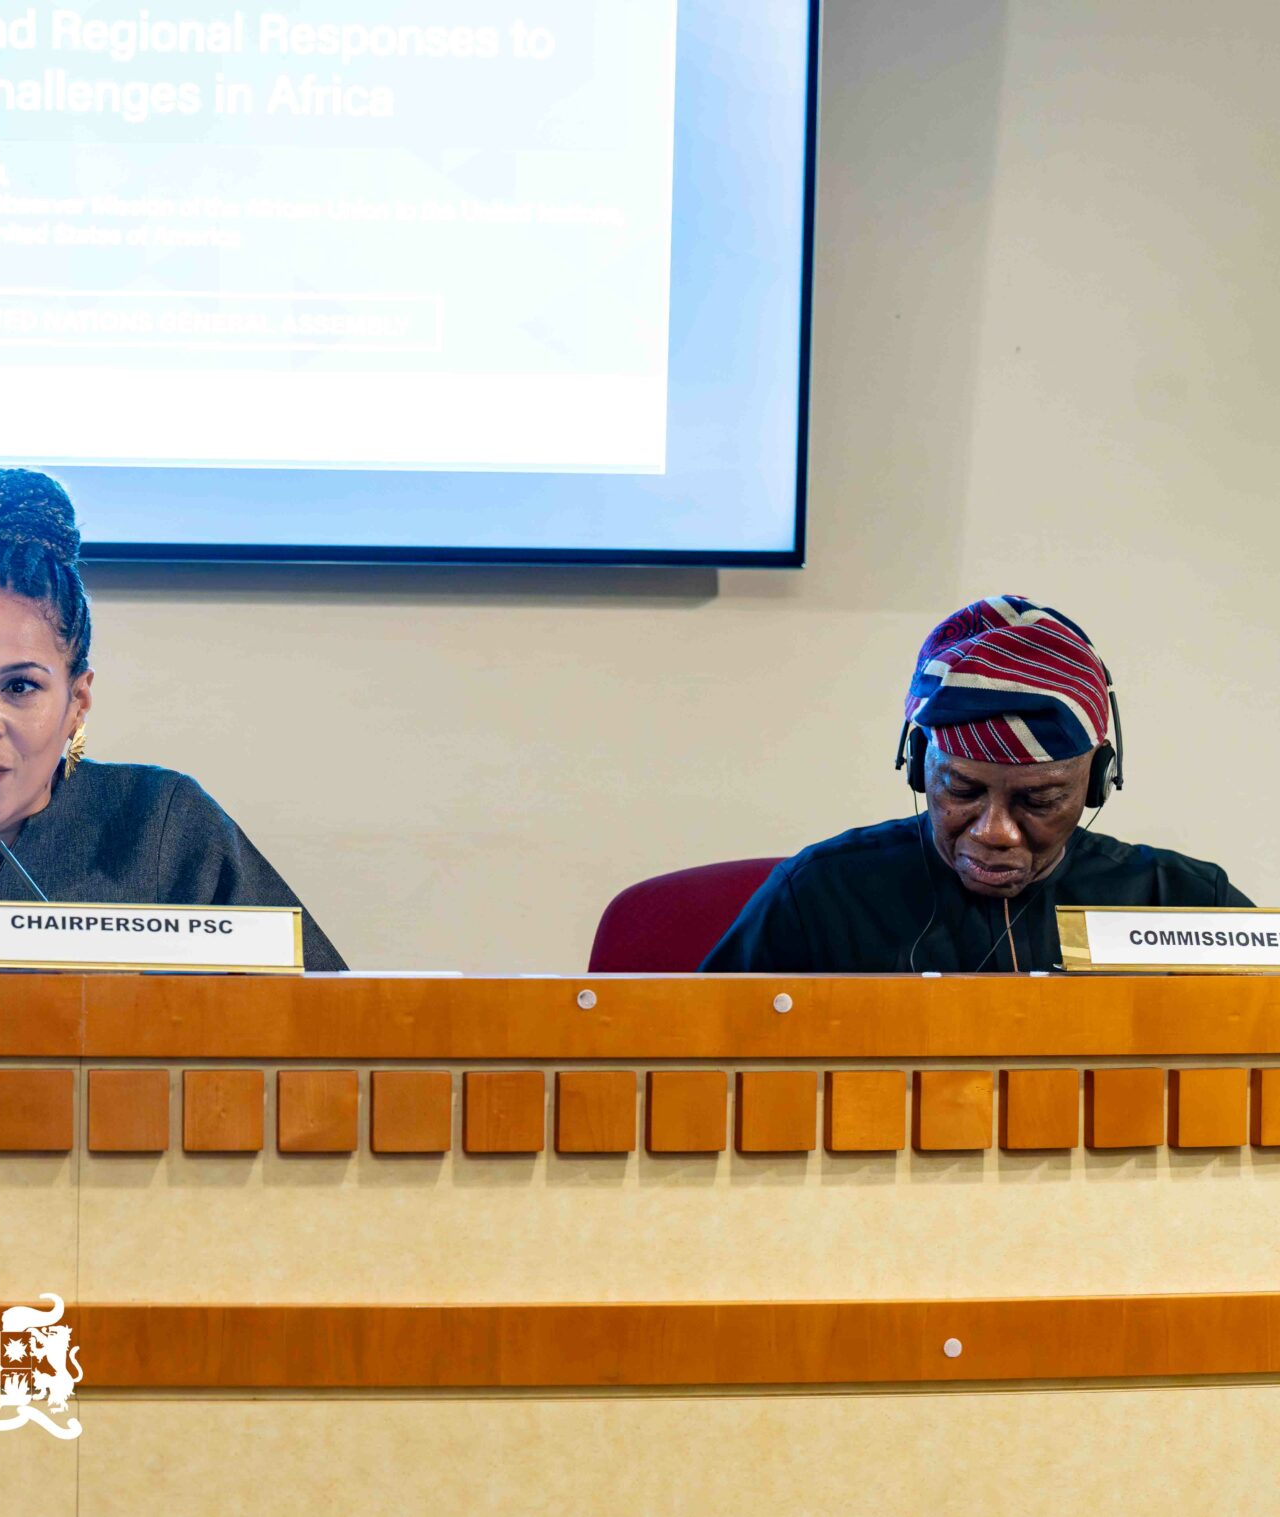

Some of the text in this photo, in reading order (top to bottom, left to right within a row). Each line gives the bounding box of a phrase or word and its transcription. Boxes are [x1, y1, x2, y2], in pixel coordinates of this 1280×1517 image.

[51, 10, 244, 61] Regional
[258, 15, 499, 64] Responses
[511, 19, 556, 59] to
[215, 71, 253, 112] in
[265, 73, 395, 117] Africa
[43, 309, 154, 334] NATIONS
[160, 311, 273, 335] GENERAL
[281, 313, 412, 337] ASSEMBLY
[10, 915, 234, 934] CHAIRPERSON PSC
[1129, 930, 1280, 947] COMMISSIONE
